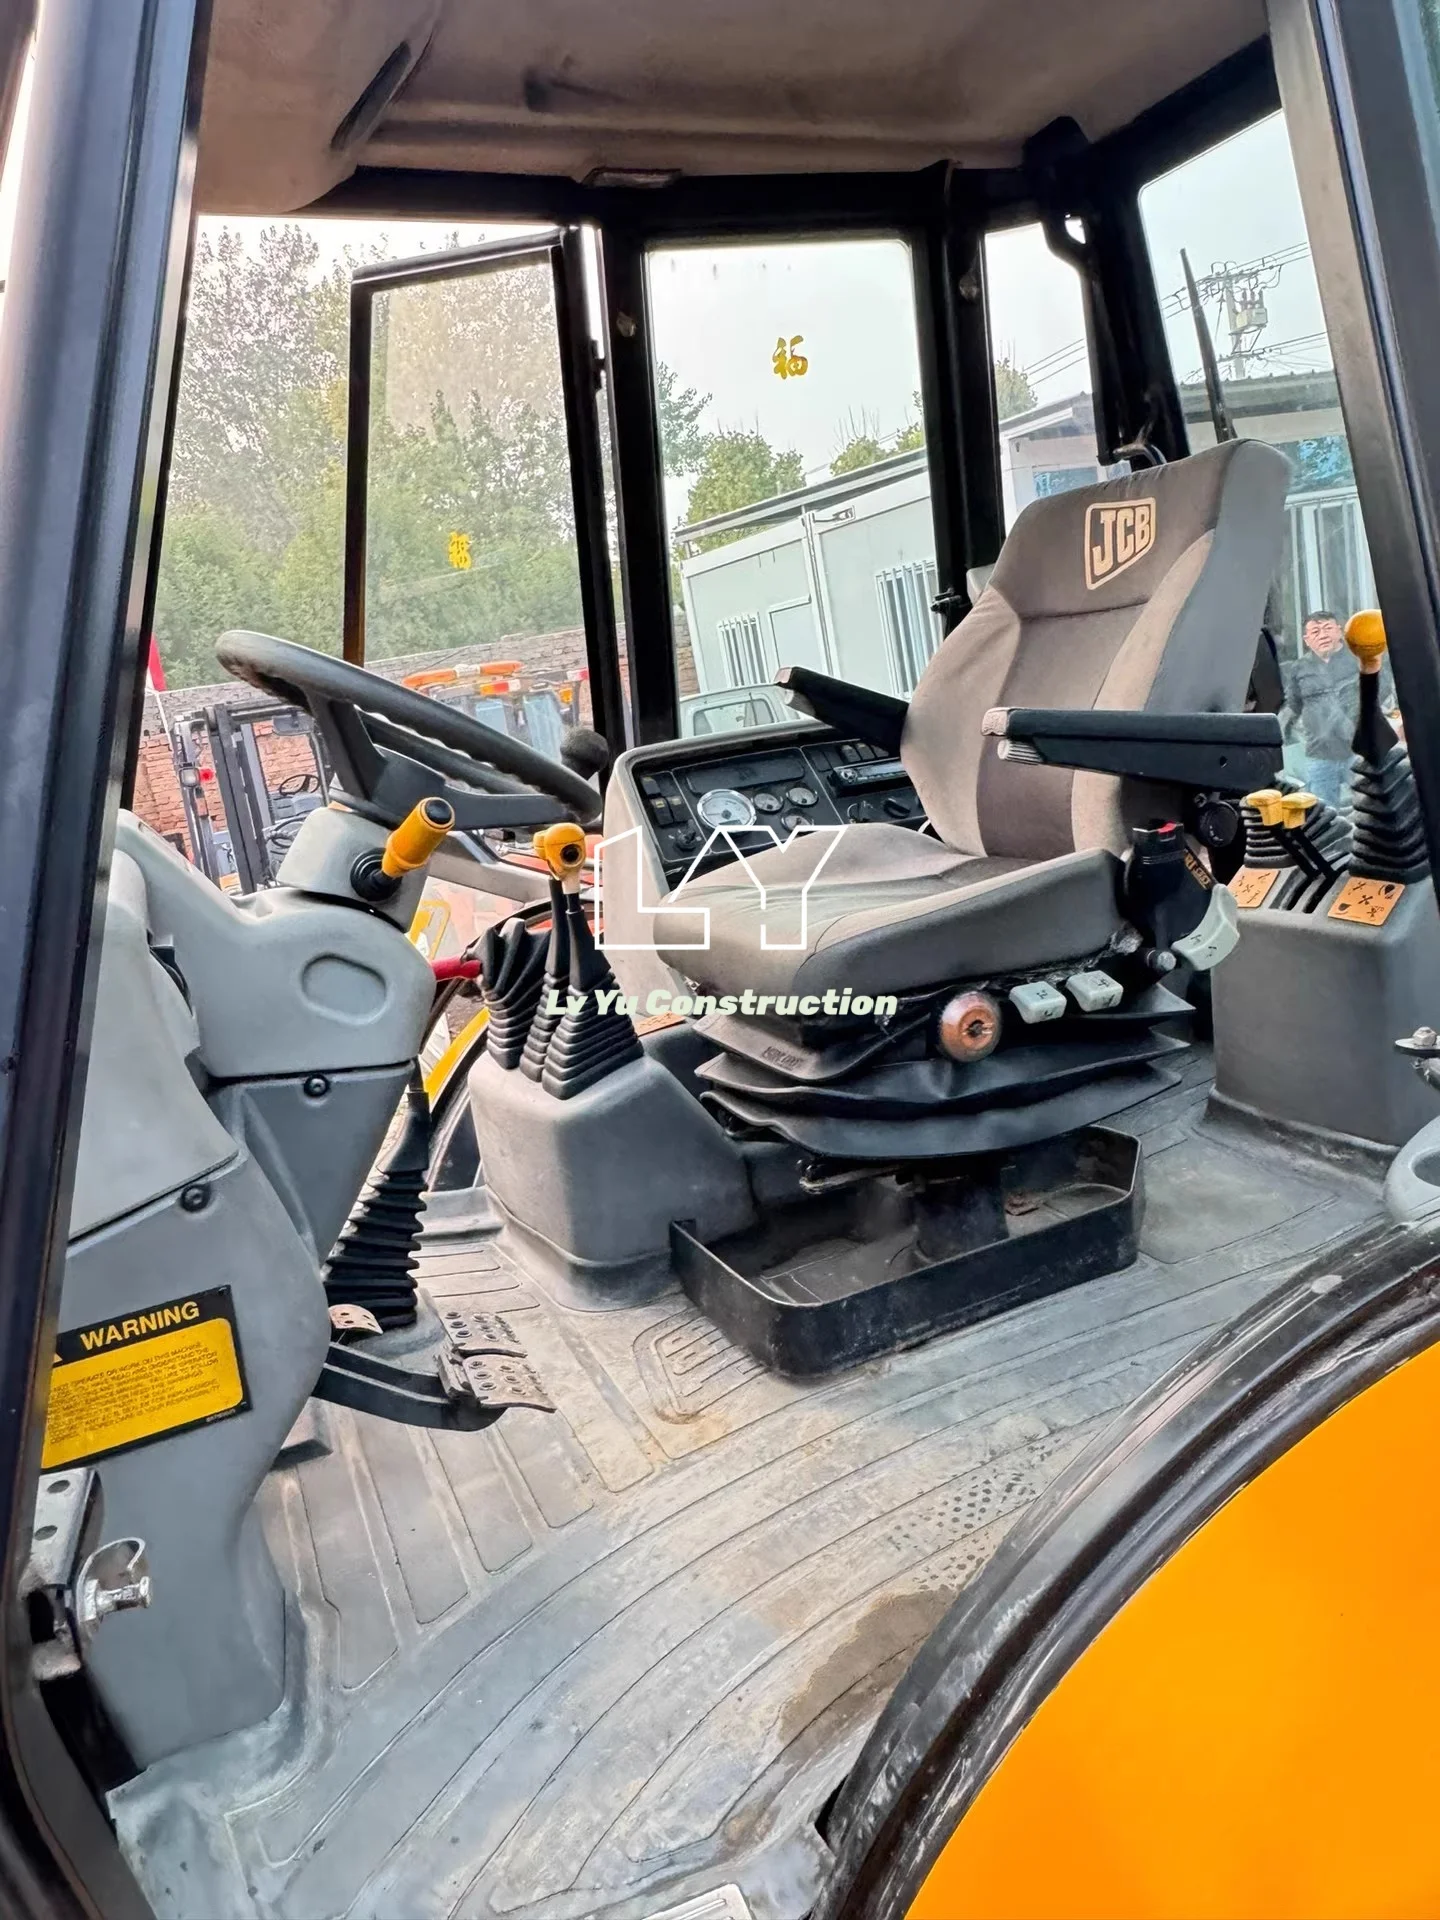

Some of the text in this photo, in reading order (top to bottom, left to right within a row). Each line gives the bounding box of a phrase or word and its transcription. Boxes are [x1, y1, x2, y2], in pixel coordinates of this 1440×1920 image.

[772, 335, 808, 380] 福
[1092, 505, 1150, 576] JCB
[80, 1301, 200, 1351] WARNING
